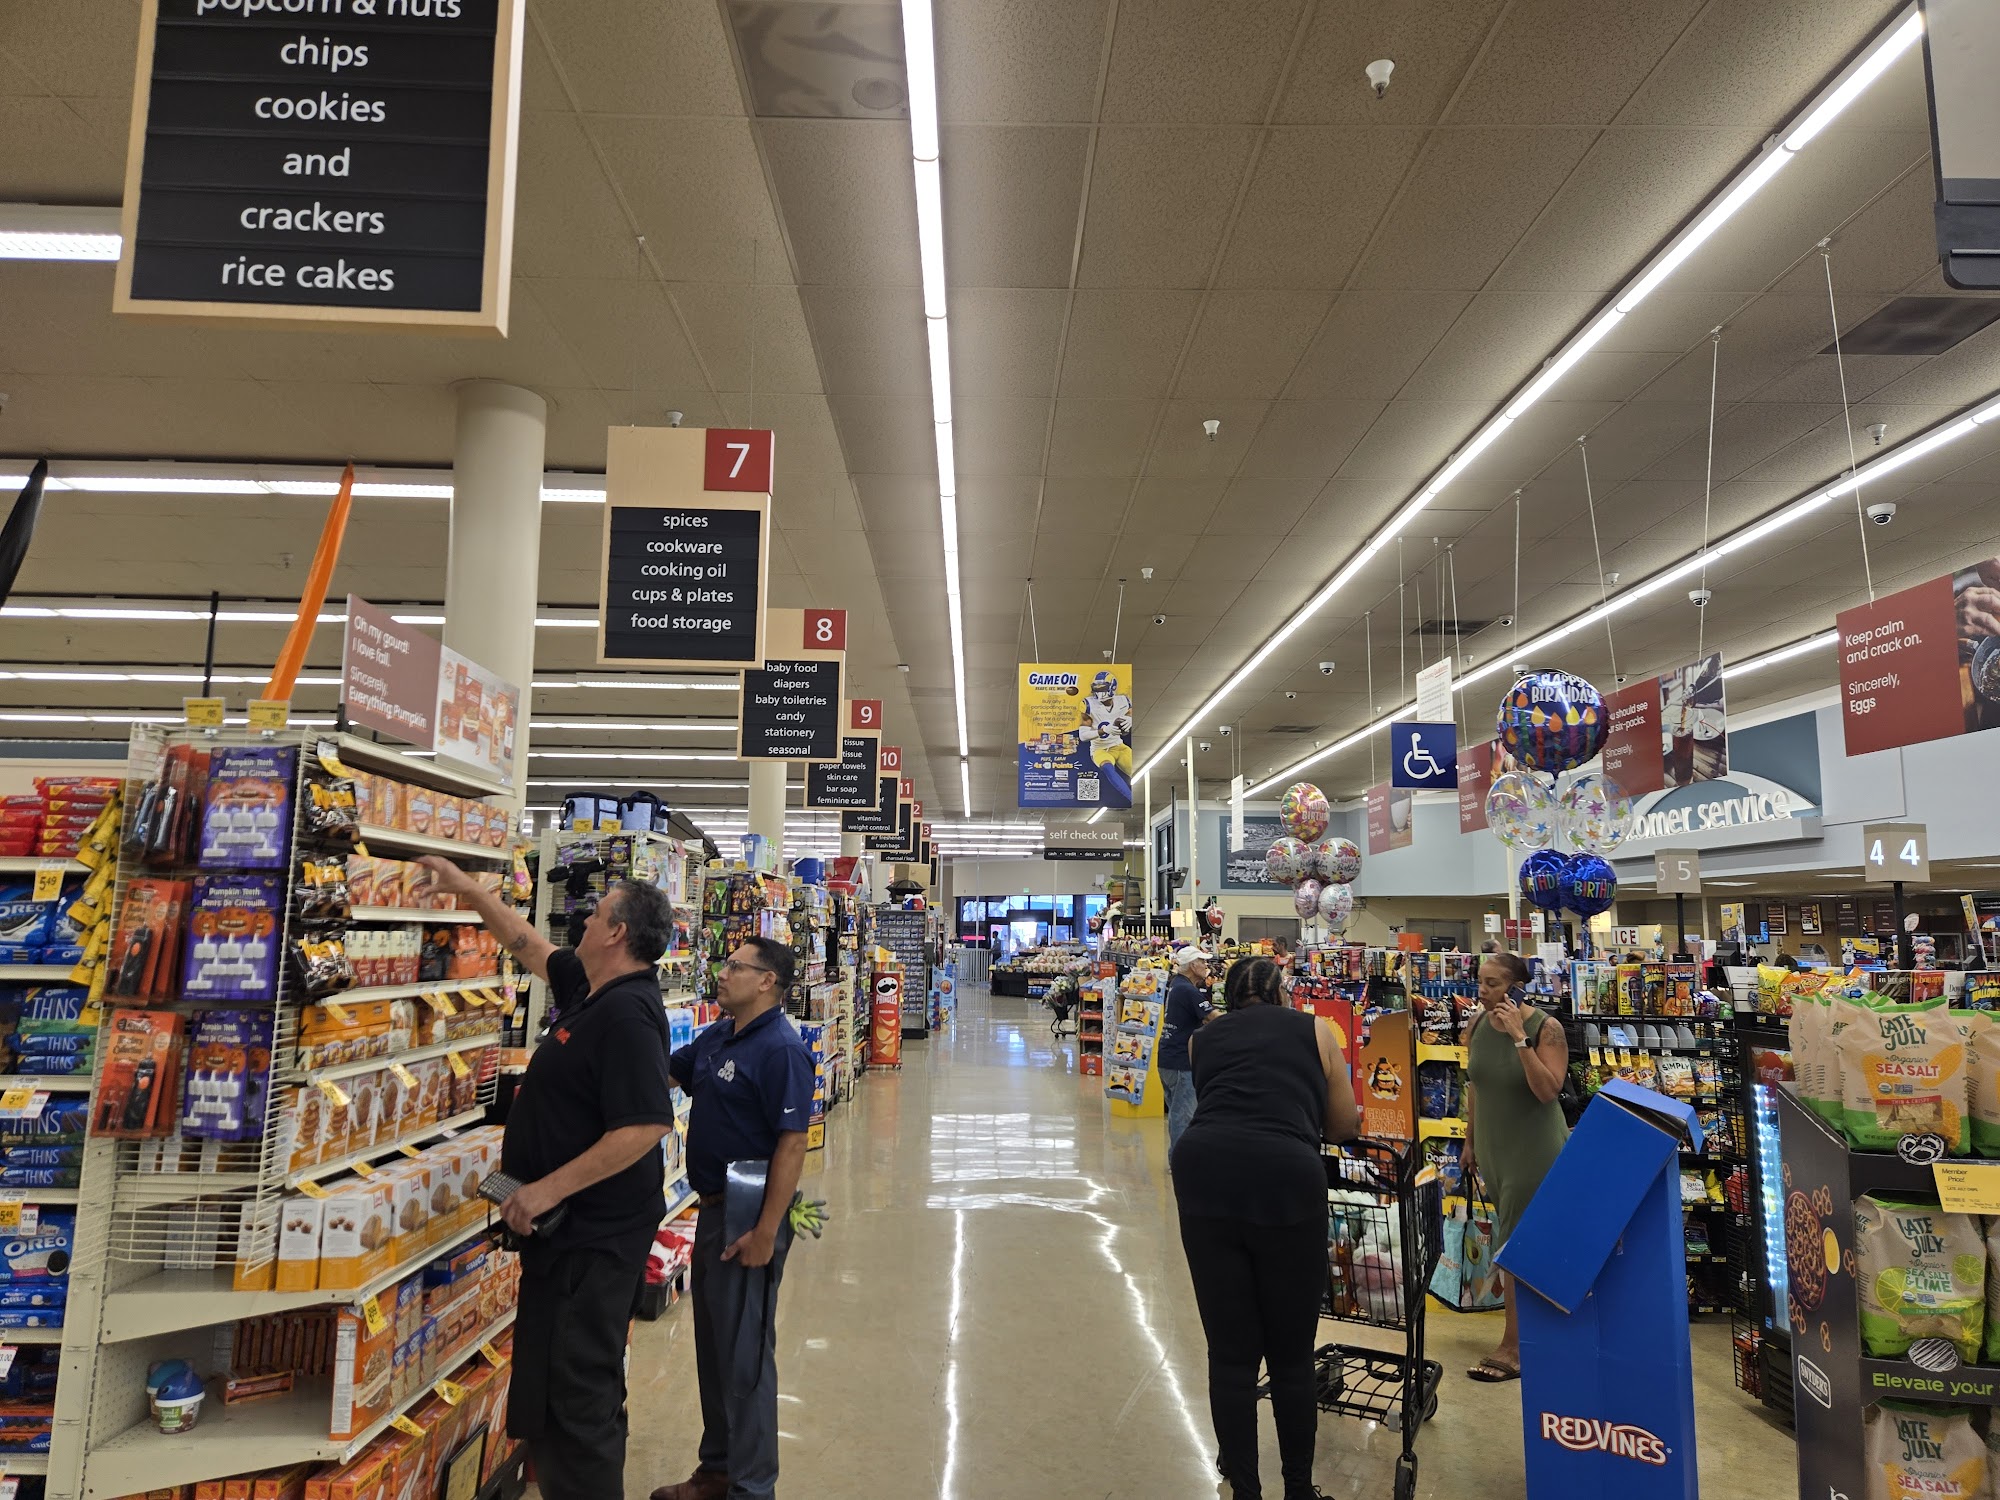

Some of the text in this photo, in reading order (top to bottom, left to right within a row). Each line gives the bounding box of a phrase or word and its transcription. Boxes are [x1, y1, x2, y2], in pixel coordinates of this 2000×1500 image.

[387, 0, 461, 18] nuts
[280, 35, 369, 73] chips
[254, 91, 386, 123] cookies
[282, 147, 350, 177] and
[240, 201, 385, 235] crackers
[221, 256, 395, 291] rice cakes
[726, 443, 750, 478] 7
[663, 513, 708, 529] spices
[646, 539, 723, 554] cookware
[641, 562, 727, 580] cooking oil
[632, 588, 734, 604] cups & plates
[631, 613, 732, 633] food storage
[816, 618, 833, 641] 8
[354, 615, 410, 654] Oh my gourd!
[1845, 619, 1904, 648] Keep calm
[356, 639, 375, 659] love
[375, 650, 391, 667] fall.
[1846, 632, 1922, 664] and crack on.
[767, 663, 818, 675] baby food
[350, 665, 389, 696] Sincerely,
[773, 679, 810, 690] diapers
[1848, 672, 1900, 696] Sincerely,
[755, 694, 827, 706] baby toiletries
[1531, 686, 1595, 704] BIRTHDAY
[349, 686, 427, 729] Everything Pumpkin
[1615, 701, 1649, 719] should see
[1850, 697, 1876, 715] Eggs
[776, 711, 805, 723] candy
[860, 706, 873, 724] 9
[1615, 715, 1645, 732] six-packs.
[765, 727, 815, 739] stationery
[768, 745, 811, 755] seasonal
[844, 739, 864, 747] tissue
[842, 750, 863, 758] tissue
[1605, 744, 1633, 758] Sincerely,
[225, 758, 274, 767] Pumpkin Teeth
[842, 762, 866, 770] towels
[881, 752, 897, 766] 10
[1606, 758, 1622, 770] Soda
[826, 773, 840, 781] skin
[826, 785, 857, 794] bar soap
[900, 783, 910, 794] 11
[817, 796, 850, 804] feminine
[1698, 790, 1793, 831] service
[1049, 830, 1118, 840] self check out
[1869, 839, 1920, 866] 4 4
[1659, 860, 1692, 881] 5 5
[209, 887, 260, 897] Pumpkin Teeth
[202, 899, 266, 907] Dents De Citrouille
[0, 904, 46, 918] OREO
[1614, 929, 1637, 945] ICE
[45, 989, 68, 997] OREO
[875, 995, 898, 1005] PRINGLES
[32, 997, 80, 1021] THINS
[1424, 1009, 1450, 1018] Doritos
[201, 1023, 237, 1033] Pumpkin Teeth
[1878, 1013, 1914, 1038] LATE
[48, 1036, 77, 1051] THINS
[196, 1034, 209, 1042] Dents
[210, 1035, 217, 1043] De
[1884, 1028, 1927, 1051] JULY
[46, 1056, 75, 1070] THINS
[1662, 1062, 1690, 1071] SIMPLY
[1889, 1055, 1924, 1064] Organic
[1876, 1063, 1939, 1077] SEA SALT
[1366, 1107, 1405, 1121] GRAB A
[31, 1149, 60, 1164] THINS
[1426, 1152, 1457, 1163] Doritos
[24, 1169, 53, 1184] THINS
[1896, 1216, 1933, 1240] LATE
[4, 1236, 67, 1257] OREO
[1911, 1235, 1944, 1258] JULY
[1913, 1259, 1941, 1269] Organic
[1905, 1267, 1950, 1280] SEA SALT
[1906, 1276, 1952, 1293] & LIME
[1872, 1372, 1993, 1396] Elevate your
[1893, 1416, 1930, 1441] LATE
[1902, 1438, 1942, 1462] JULY
[1908, 1466, 1943, 1479] Organic
[1897, 1474, 1960, 1493] SEA SALT
